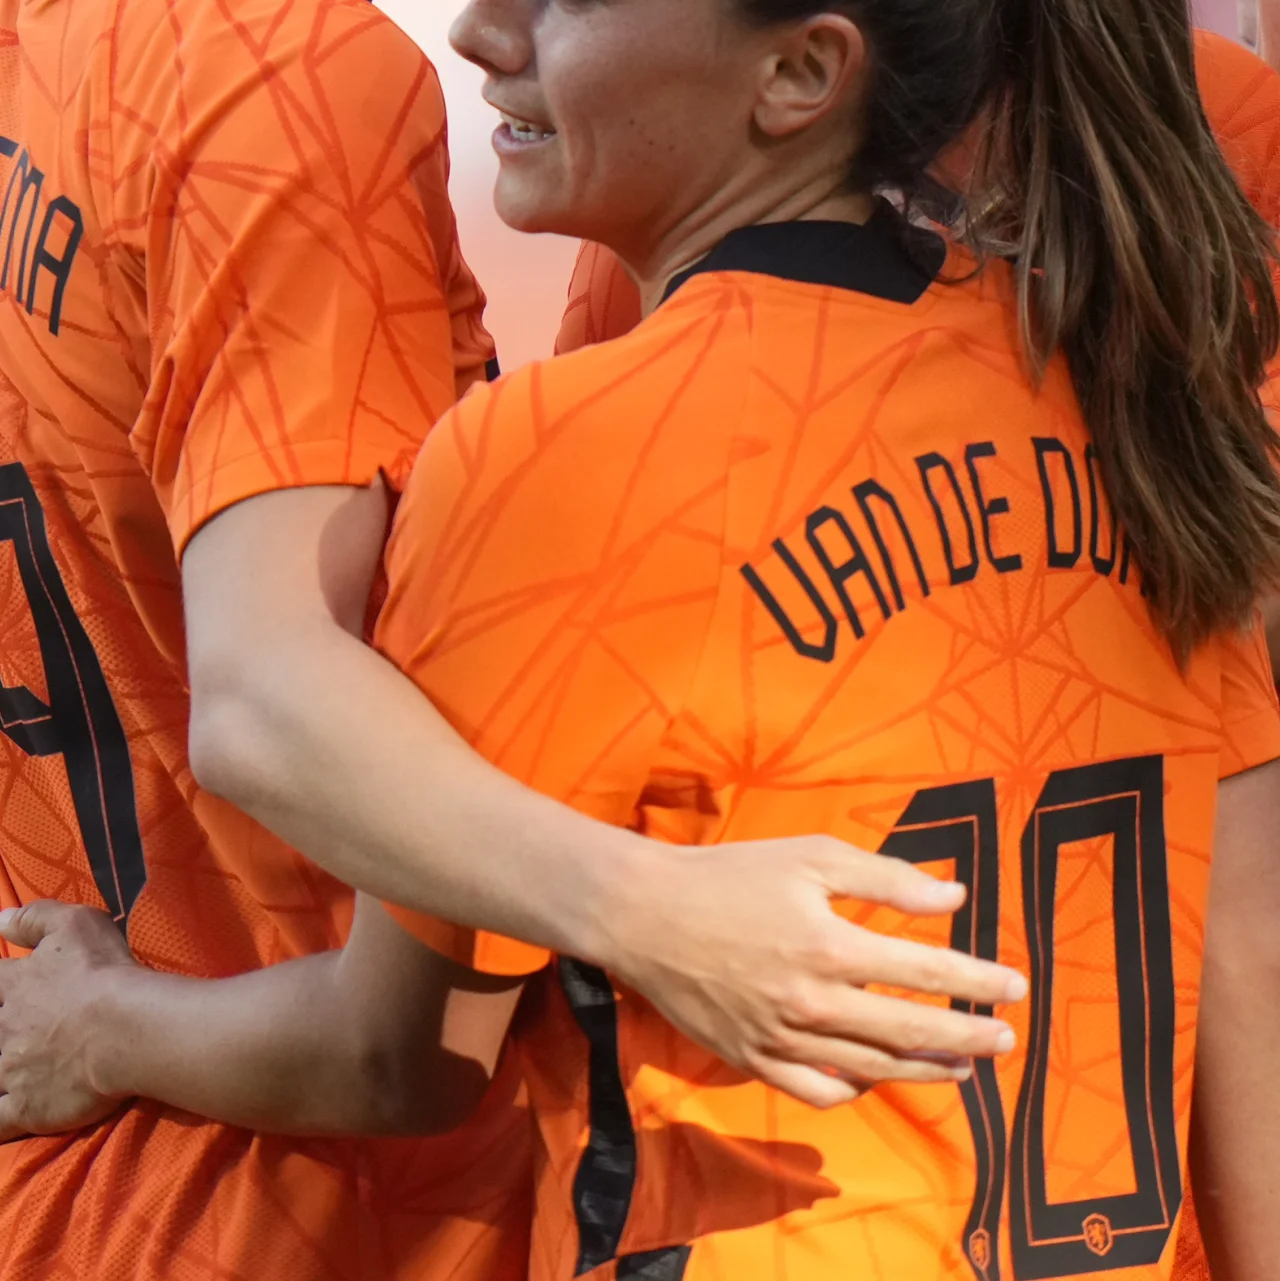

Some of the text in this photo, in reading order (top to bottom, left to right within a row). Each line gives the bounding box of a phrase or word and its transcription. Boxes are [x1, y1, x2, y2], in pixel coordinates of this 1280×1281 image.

[739, 436, 1158, 662] VAN DE DO
[874, 753, 1183, 1281] 10
